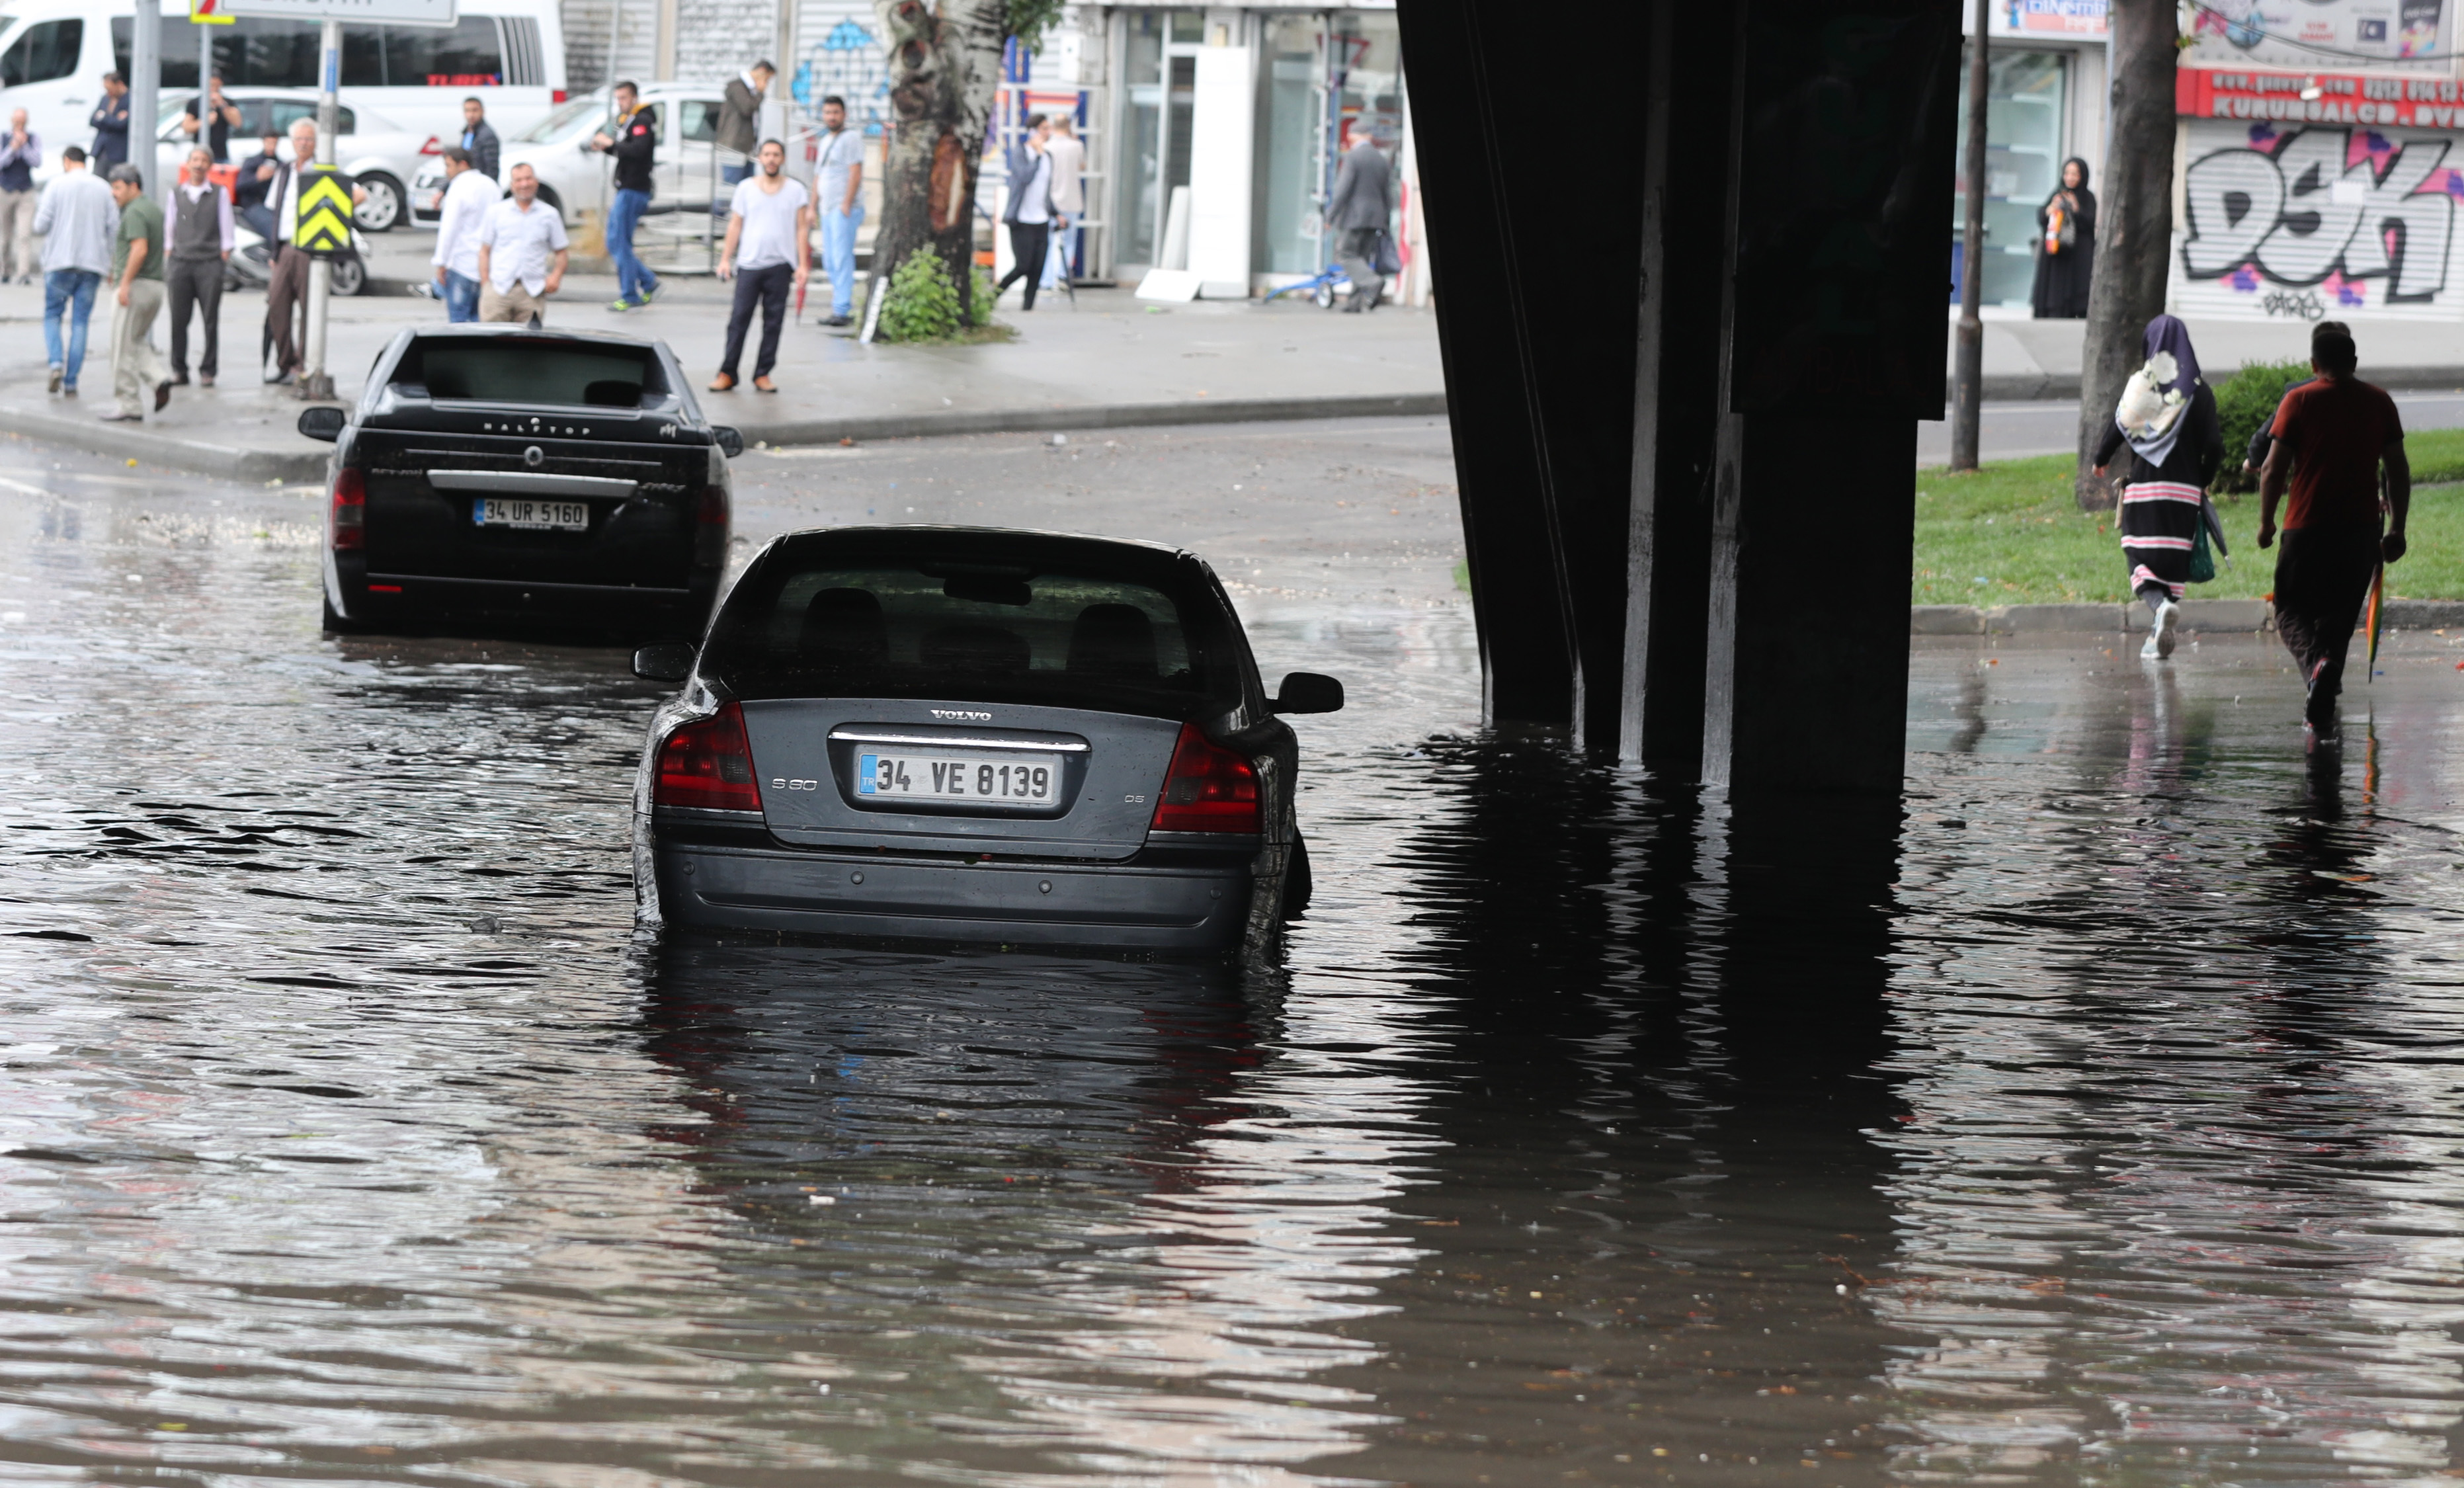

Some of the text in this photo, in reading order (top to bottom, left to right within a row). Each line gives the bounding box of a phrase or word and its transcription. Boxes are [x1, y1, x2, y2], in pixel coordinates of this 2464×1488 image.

[486, 501, 506, 520] 34
[513, 502, 533, 521] UR
[541, 503, 583, 524] 5160
[930, 709, 992, 722] VOLVO
[862, 776, 875, 787] TR
[877, 759, 1049, 798] 34 VE 8139
